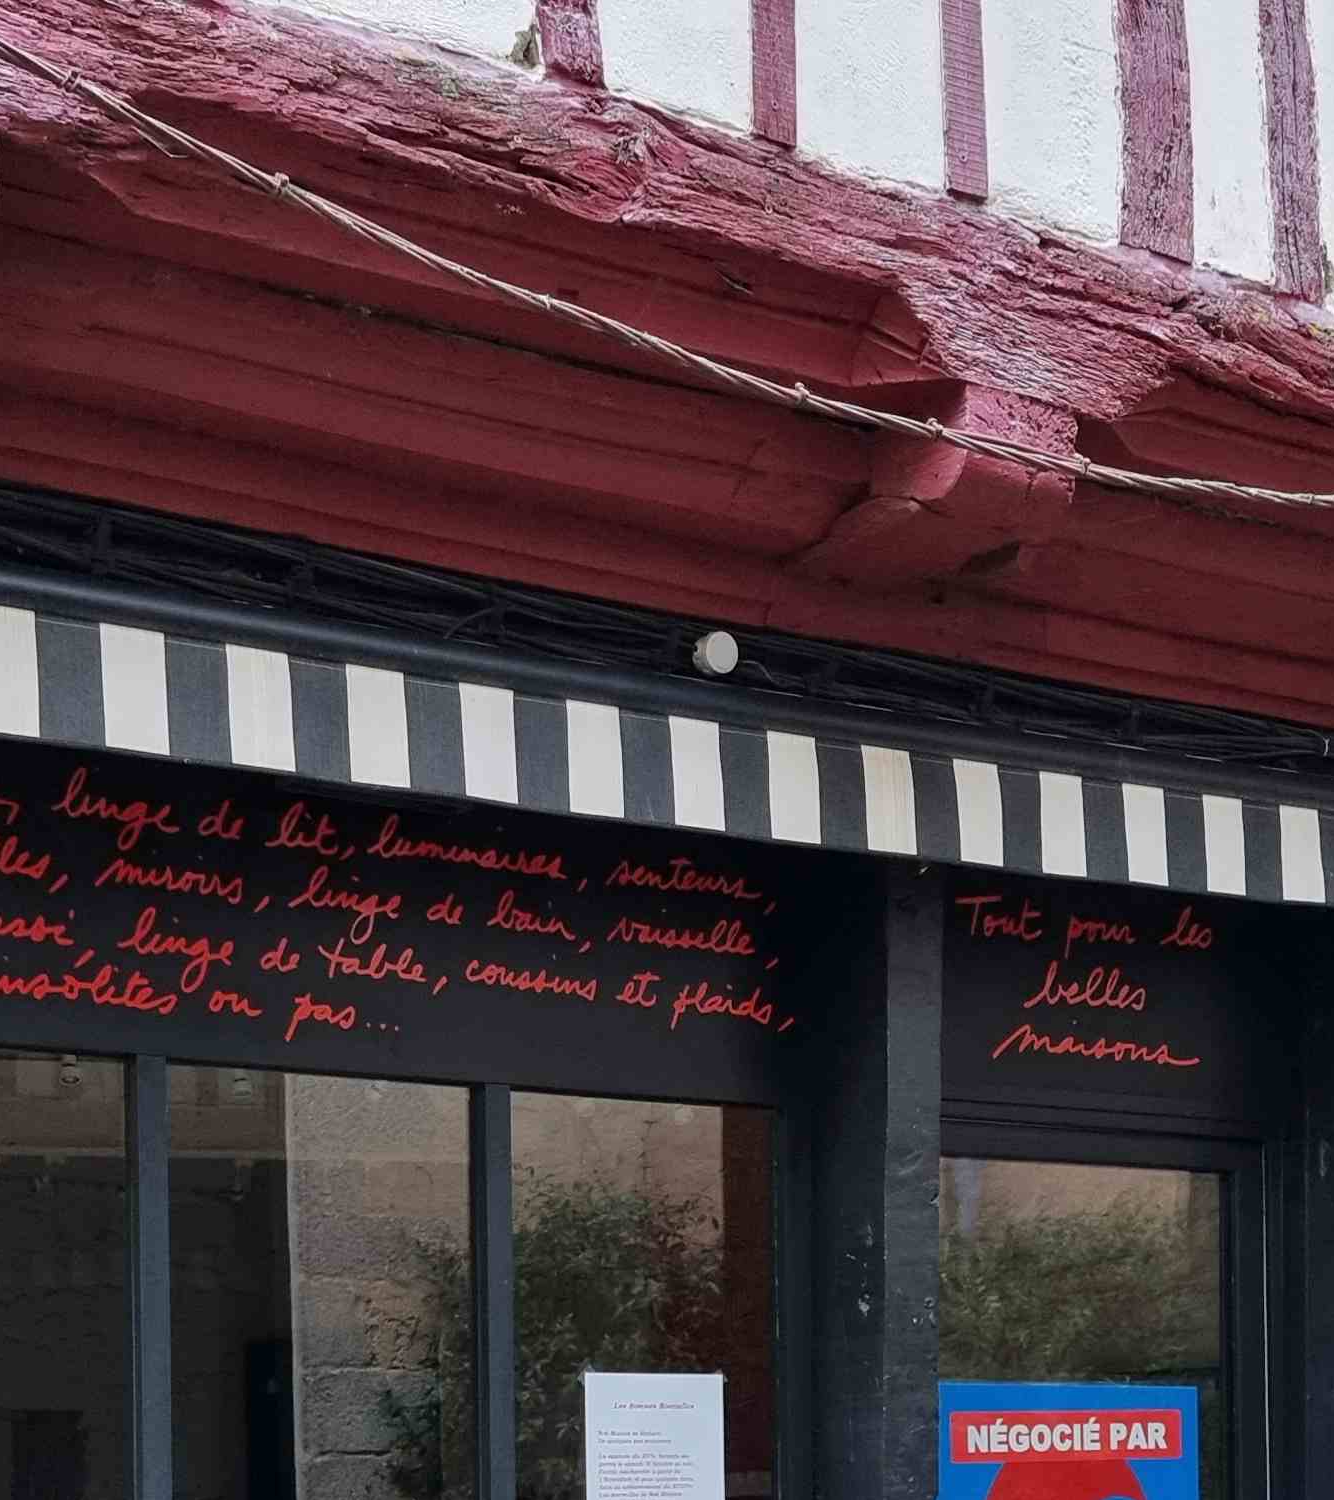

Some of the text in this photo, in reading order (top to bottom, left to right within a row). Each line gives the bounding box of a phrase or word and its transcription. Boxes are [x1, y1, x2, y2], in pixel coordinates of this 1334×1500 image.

[51, 767, 181, 851] linge
[198, 798, 247, 839] de
[264, 801, 355, 860] lit,
[288, 865, 402, 943] linge
[426, 893, 463, 926] de
[955, 895, 1213, 960] Tout pour les
[117, 906, 234, 993] linge
[260, 936, 300, 974] de
[318, 937, 449, 996] table,
[466, 956, 599, 1001] coussins
[616, 970, 658, 1008] et
[1023, 960, 1149, 1012] belles
[209, 988, 264, 1018] ou
[966, 1417, 1169, 1454] NÉGOCIÉ PAR
